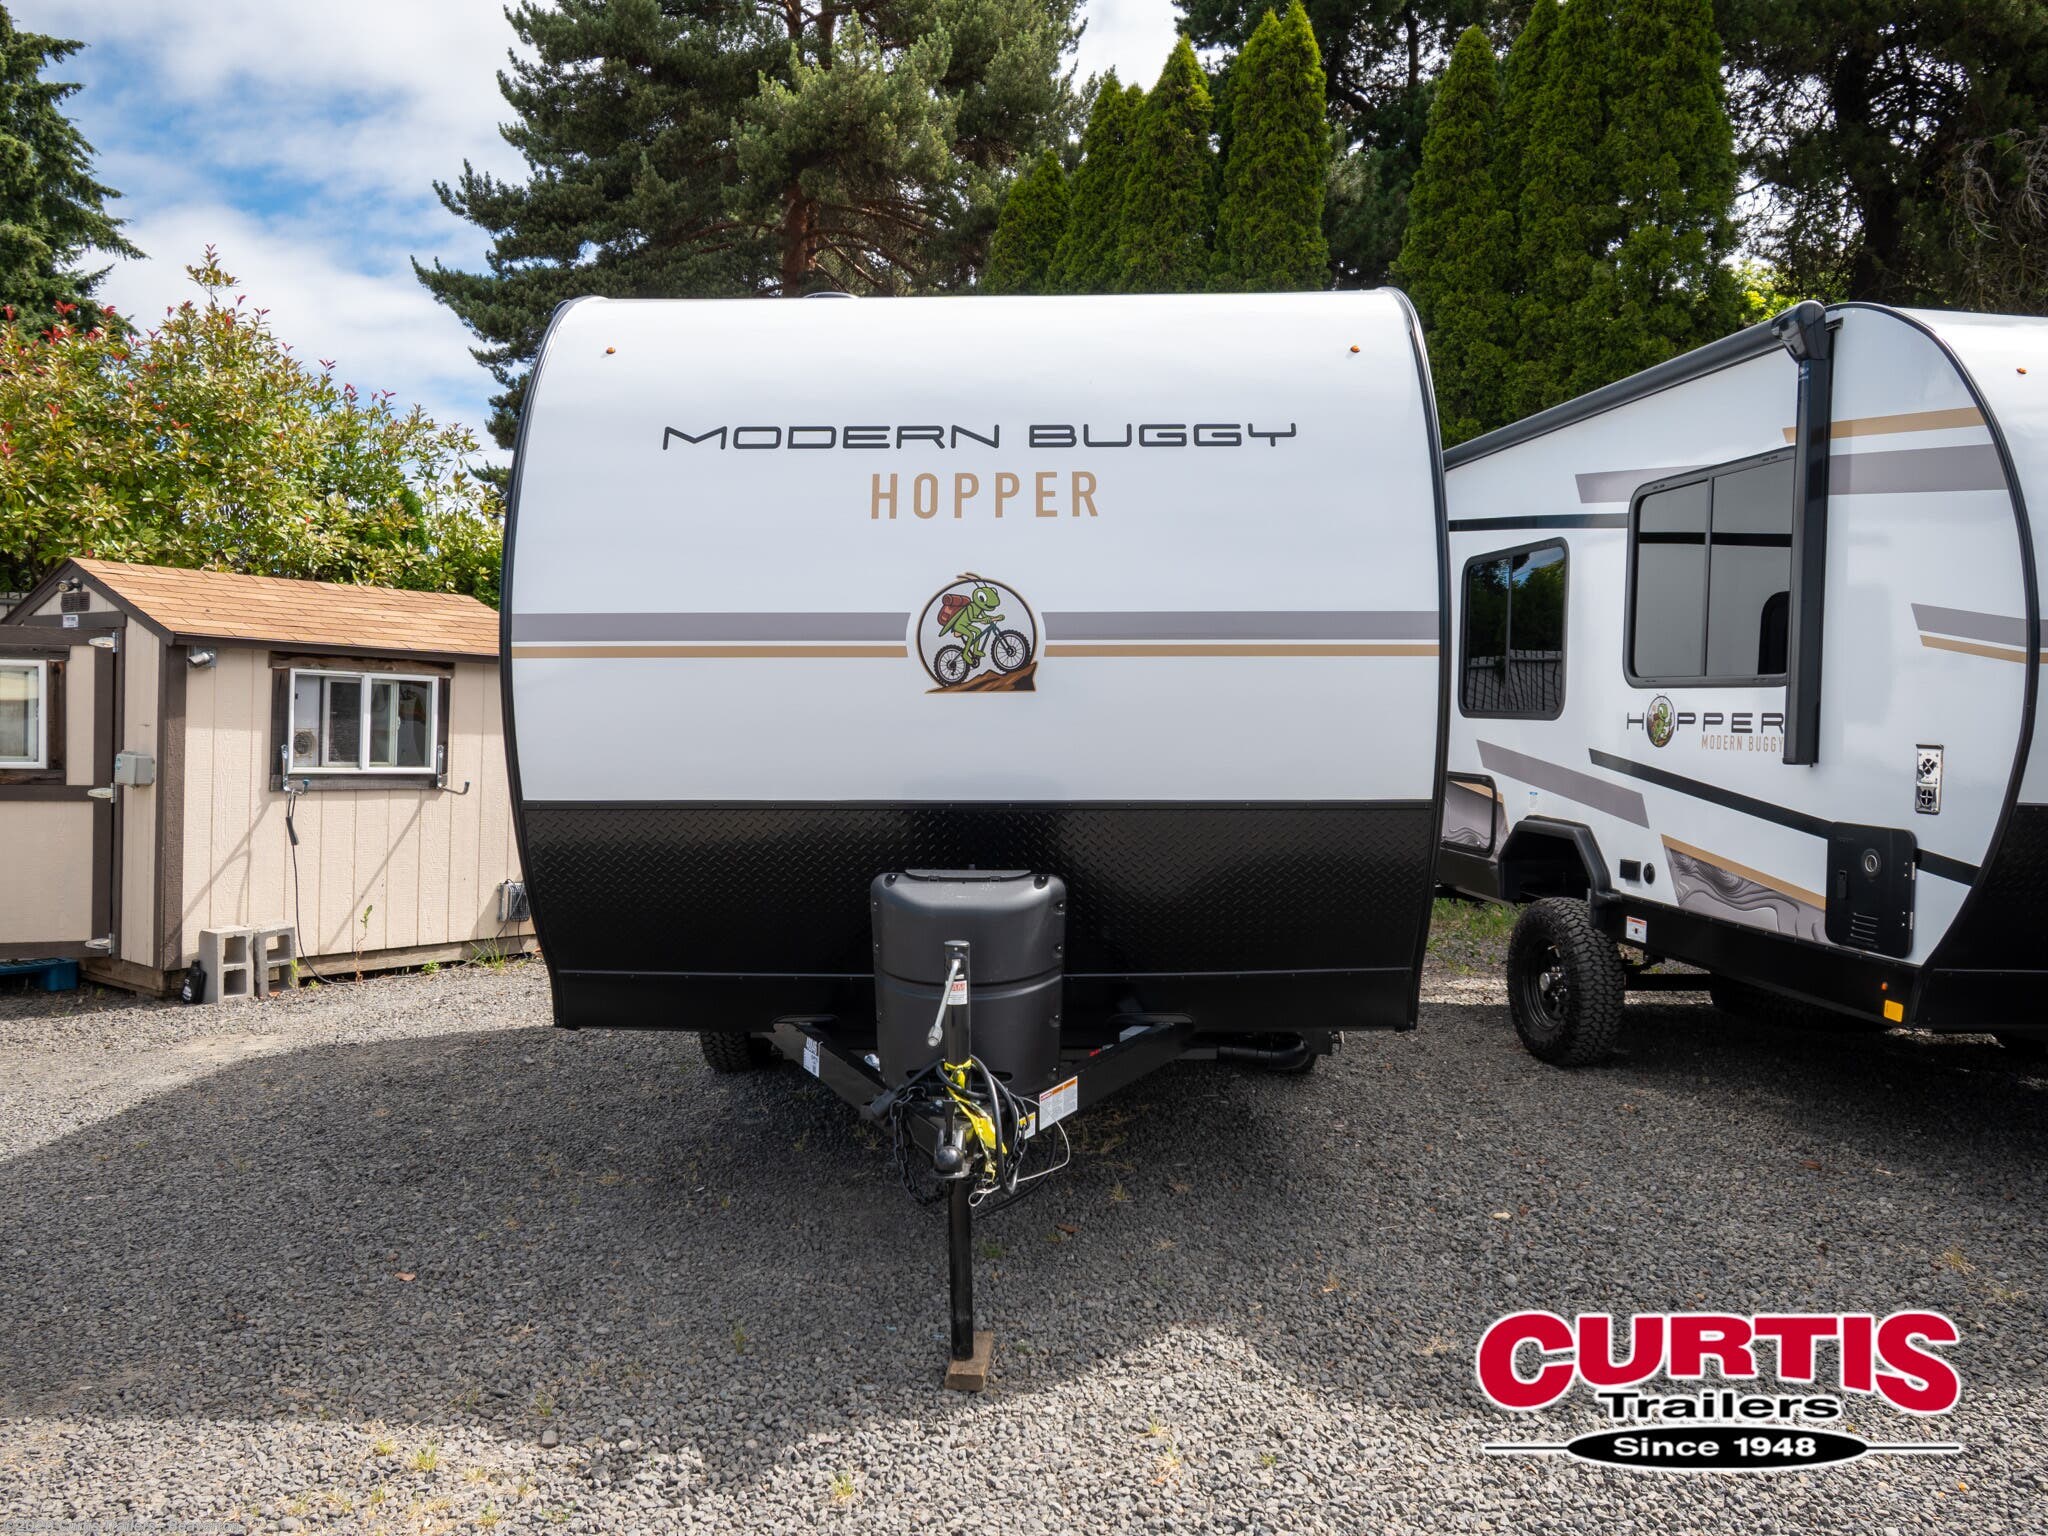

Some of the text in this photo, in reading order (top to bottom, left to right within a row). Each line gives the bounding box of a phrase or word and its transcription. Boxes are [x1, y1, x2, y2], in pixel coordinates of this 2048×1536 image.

[662, 422, 1297, 450] MODERN BUGGY
[871, 471, 1098, 519] HOPPER
[1701, 734, 1785, 753] MODERN BUGGY
